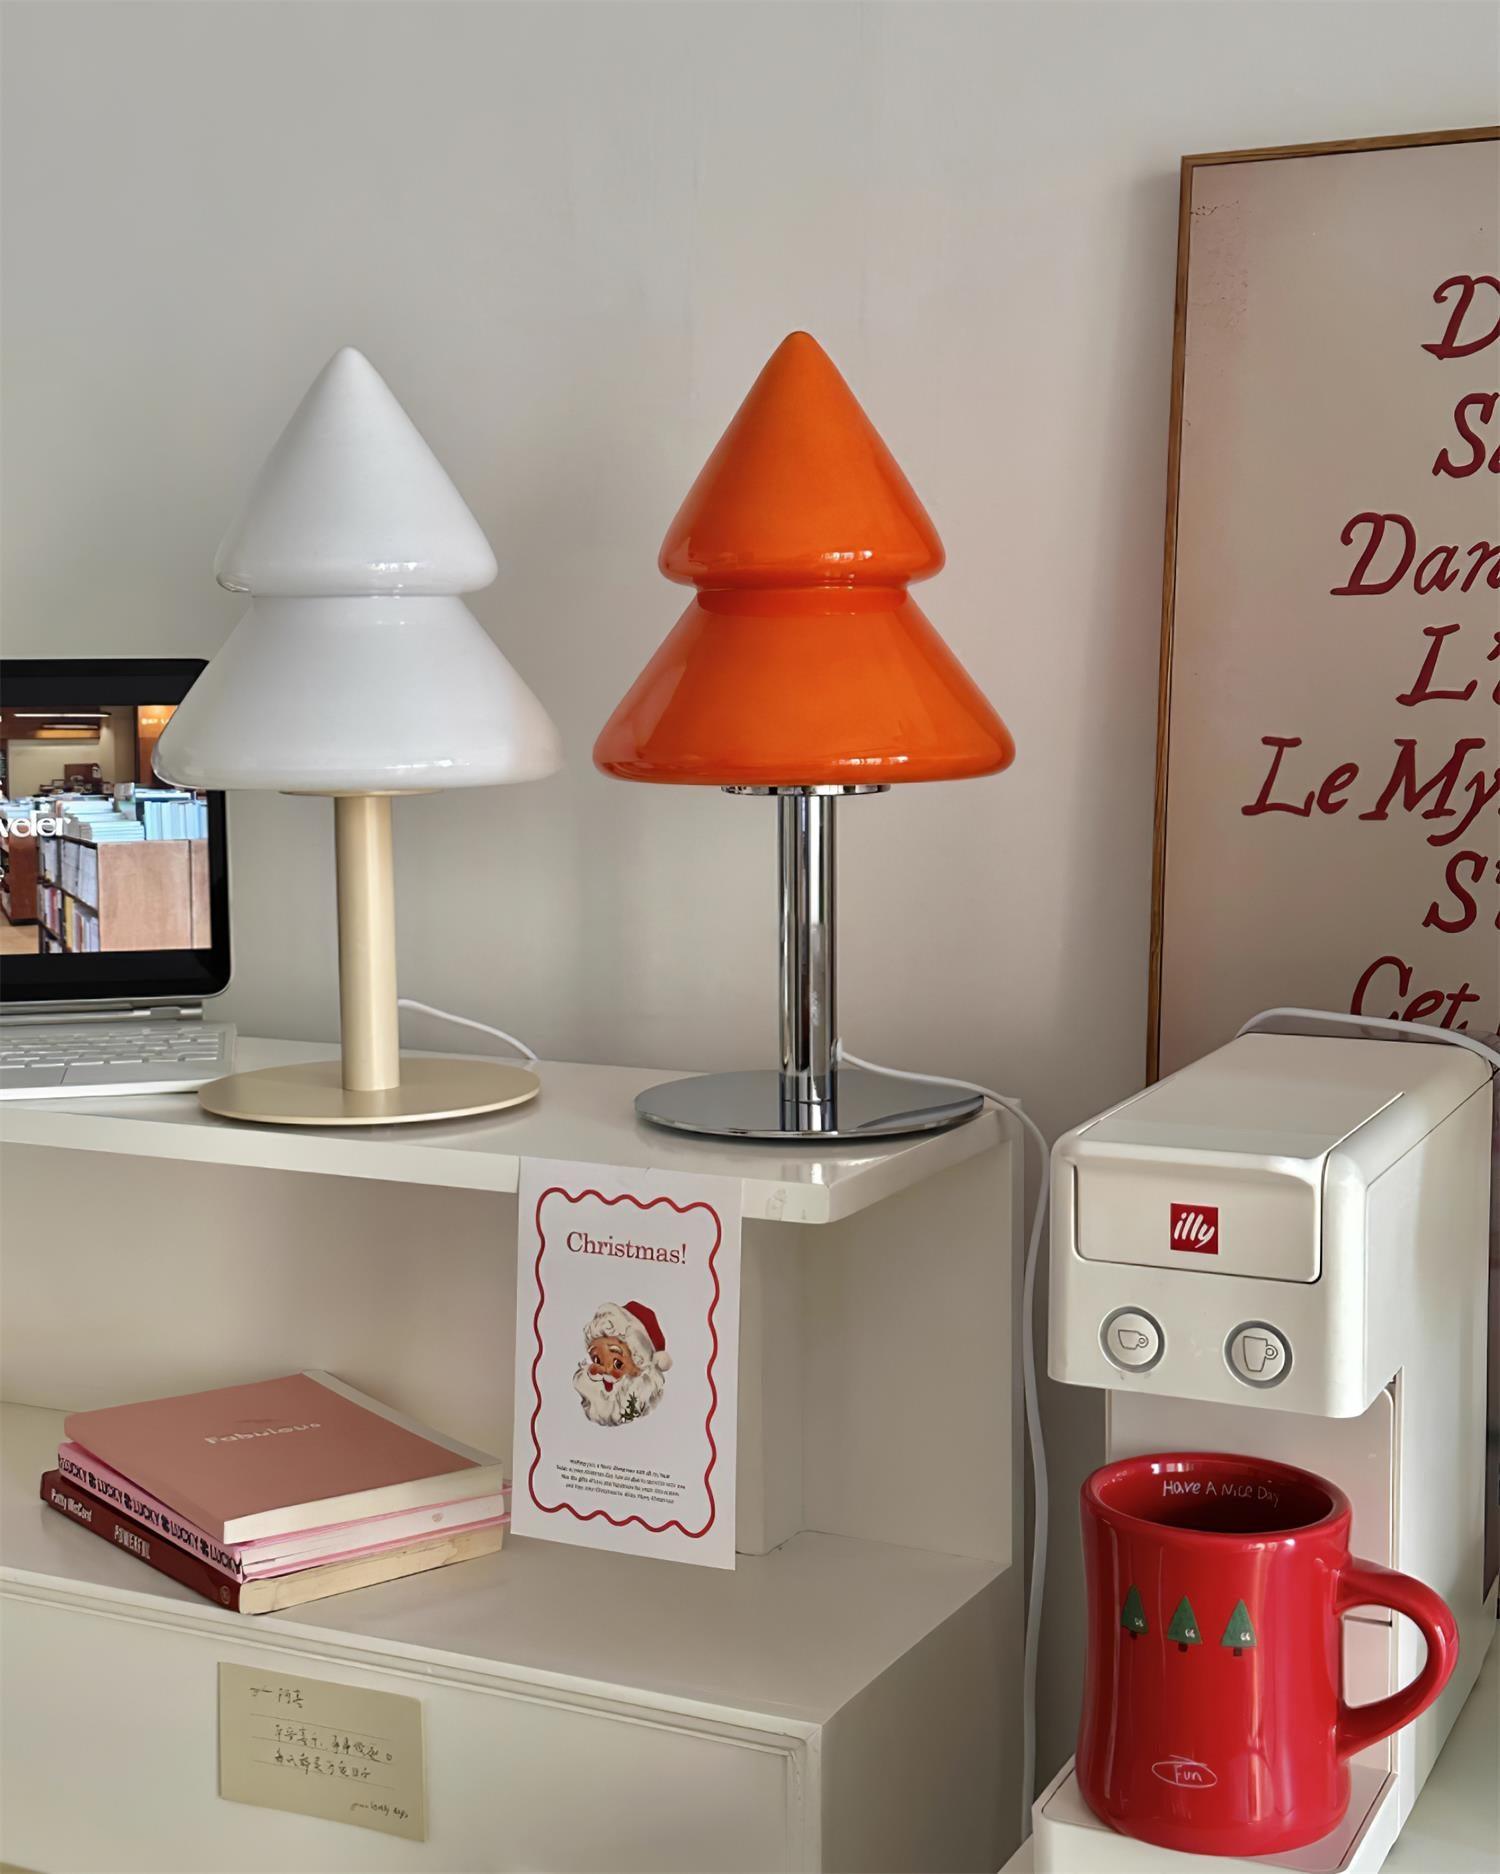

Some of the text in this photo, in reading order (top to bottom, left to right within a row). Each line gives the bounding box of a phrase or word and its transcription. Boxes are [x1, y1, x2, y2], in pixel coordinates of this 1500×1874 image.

[1432, 392, 1500, 478] S
[1241, 736, 1500, 847] Le My
[566, 1231, 687, 1265] Christmas!
[1173, 1211, 1216, 1249] illy
[1162, 1480, 1201, 1497] Have
[1205, 1480, 1218, 1496] A
[132, 1499, 161, 1527] LUCKY
[170, 1520, 199, 1552] LUCKY
[209, 1543, 242, 1575] LUCKY
[1173, 1764, 1203, 1785] Fun
